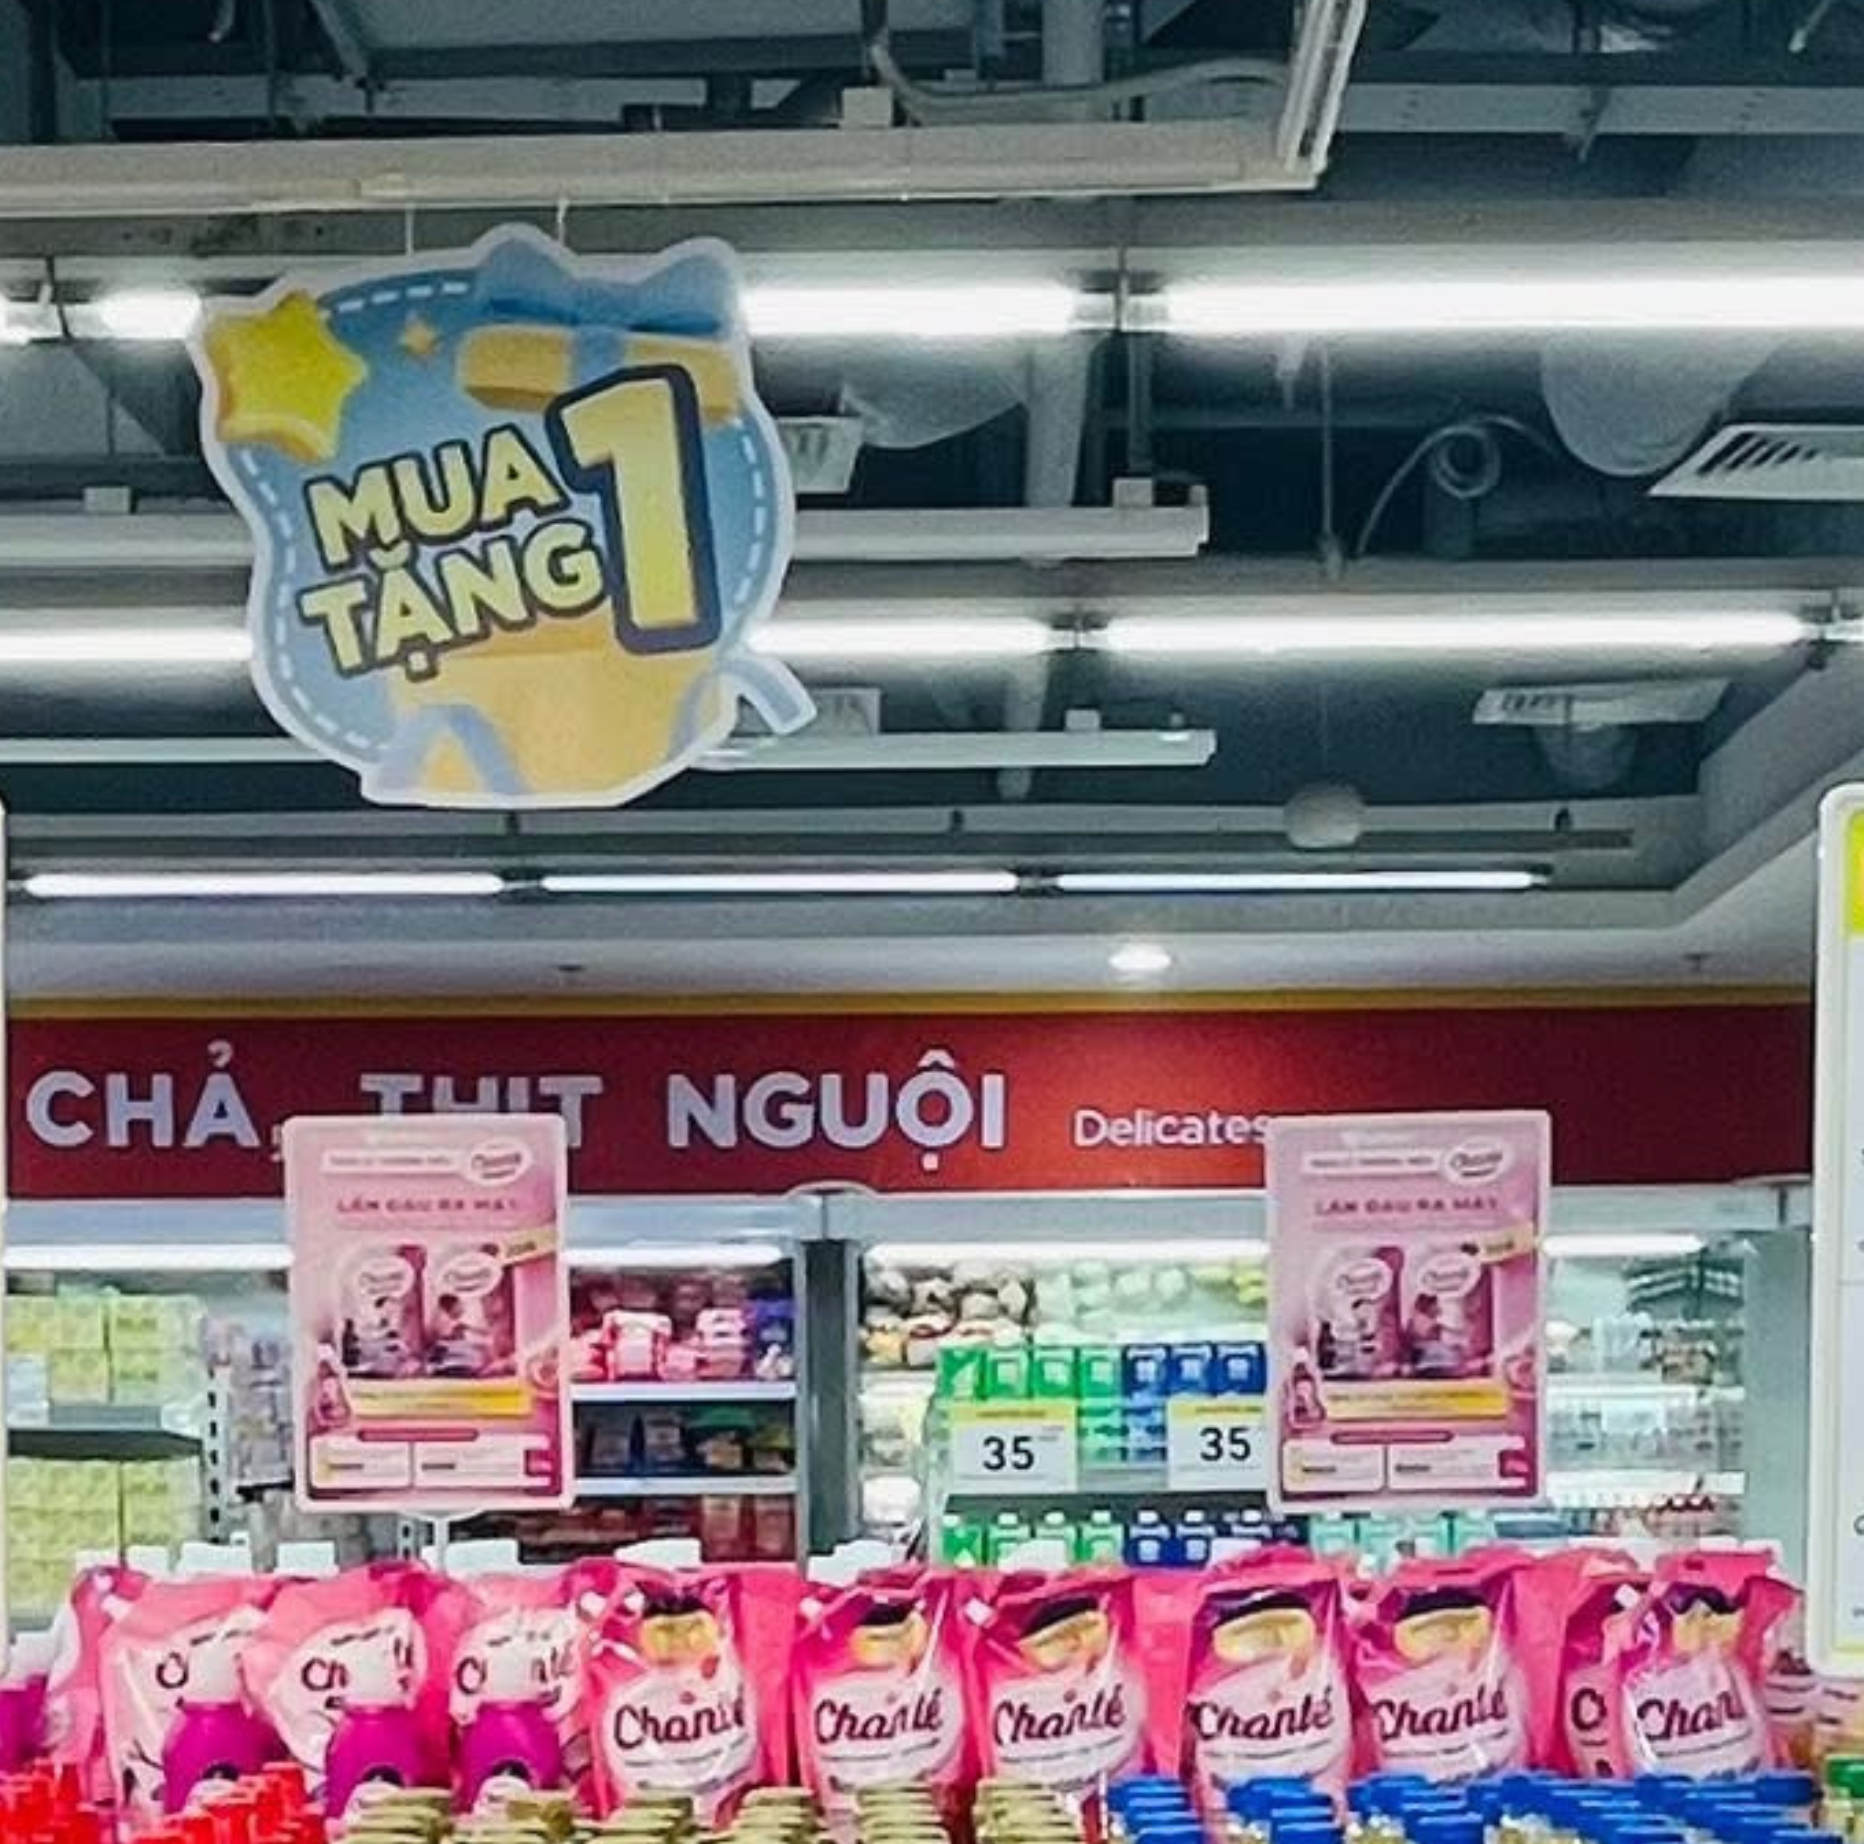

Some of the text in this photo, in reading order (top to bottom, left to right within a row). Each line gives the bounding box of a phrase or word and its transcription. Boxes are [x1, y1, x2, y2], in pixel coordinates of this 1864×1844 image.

[305, 424, 567, 570] MUA
[549, 367, 717, 652] 1
[299, 520, 609, 678] TẶNG
[666, 1048, 1005, 1172] NGUỘI
[982, 1436, 1035, 1471] 35
[1199, 1426, 1253, 1463] 35
